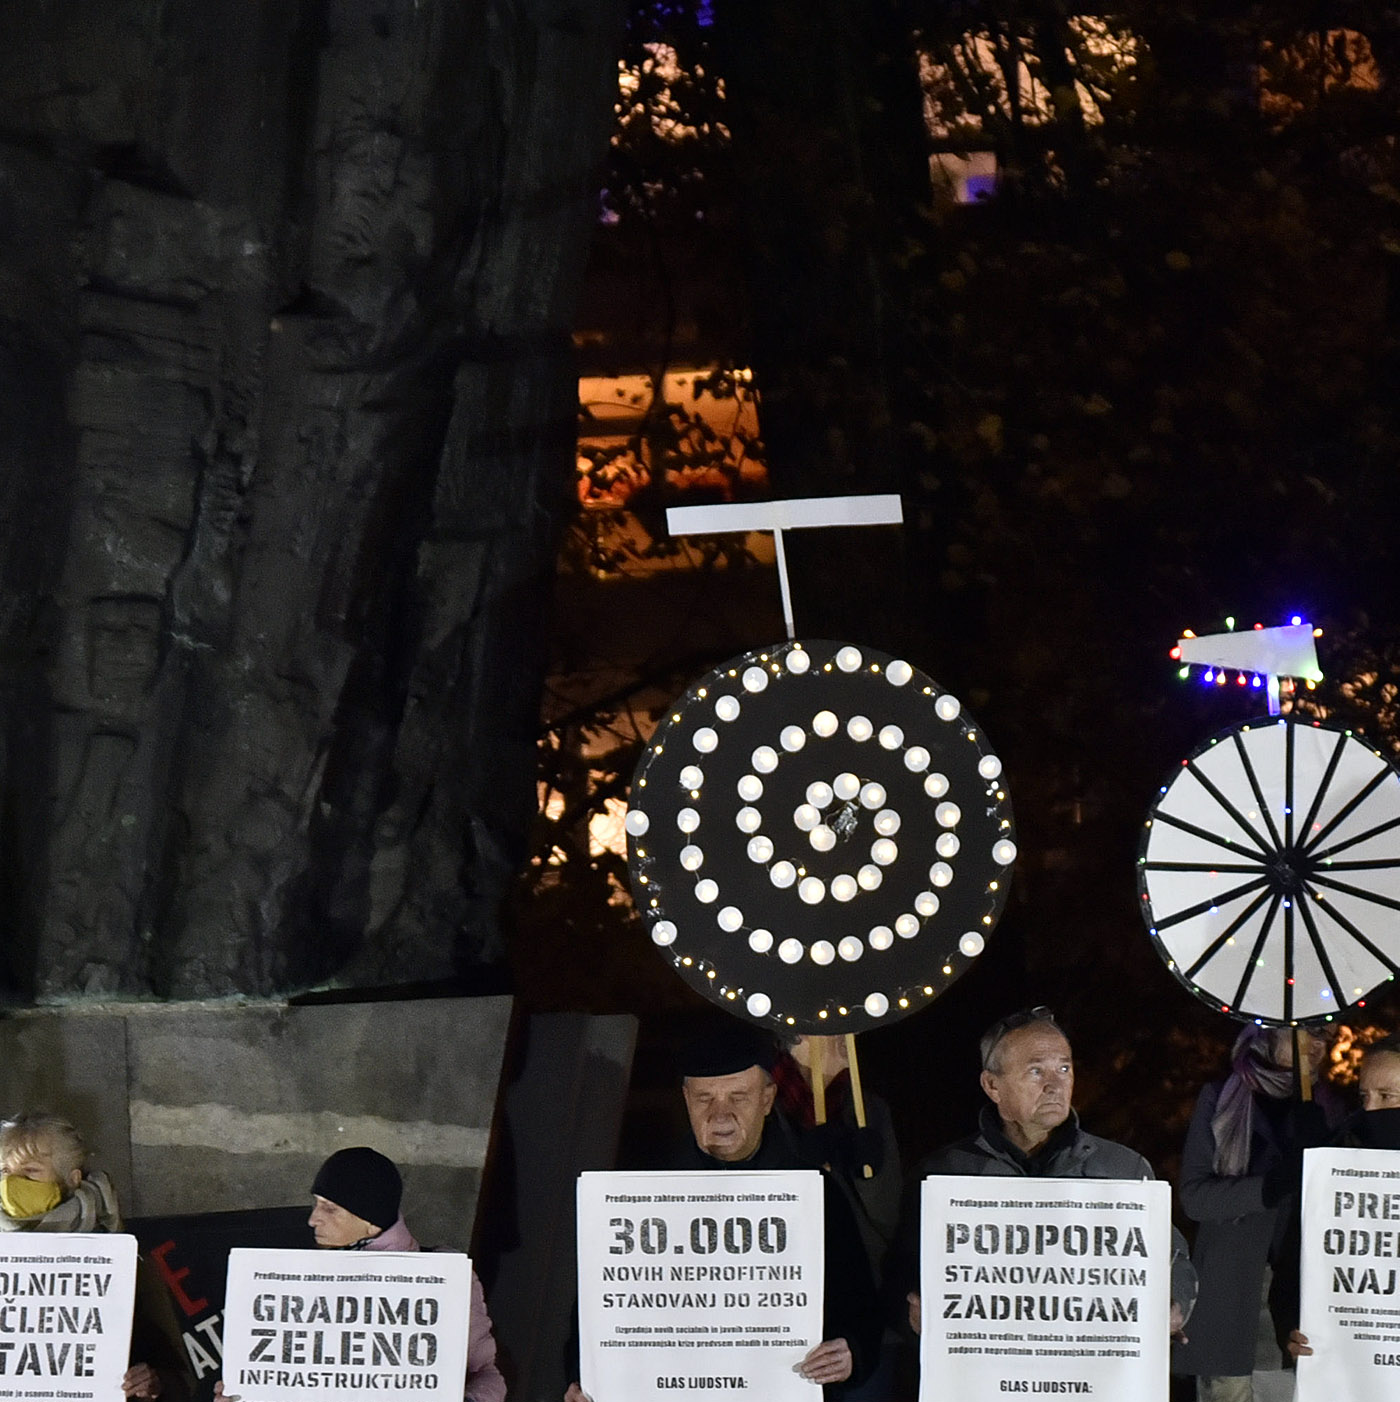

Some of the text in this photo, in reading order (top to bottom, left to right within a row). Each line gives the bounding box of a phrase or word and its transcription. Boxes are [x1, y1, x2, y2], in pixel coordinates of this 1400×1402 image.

[609, 1217, 787, 1255] 30.000
[945, 1224, 1149, 1257] PODPORA
[602, 1265, 802, 1281] NOVIH NEPROFITNIH
[945, 1265, 1146, 1286] STANOVANJSKIM
[252, 1295, 439, 1325] GRADIMO
[603, 1292, 808, 1308] STANOVANJ DO 2030
[942, 1294, 1138, 1322] ZADRUGAM
[0, 1299, 104, 1334] ČLENA
[248, 1329, 437, 1366] ZELENO
[239, 1369, 438, 1389] INFRASTRUKTURO
[656, 1376, 748, 1389] GLAS LJUDSTVA:
[999, 1380, 1093, 1393] GLAS LJUDSTVA:
